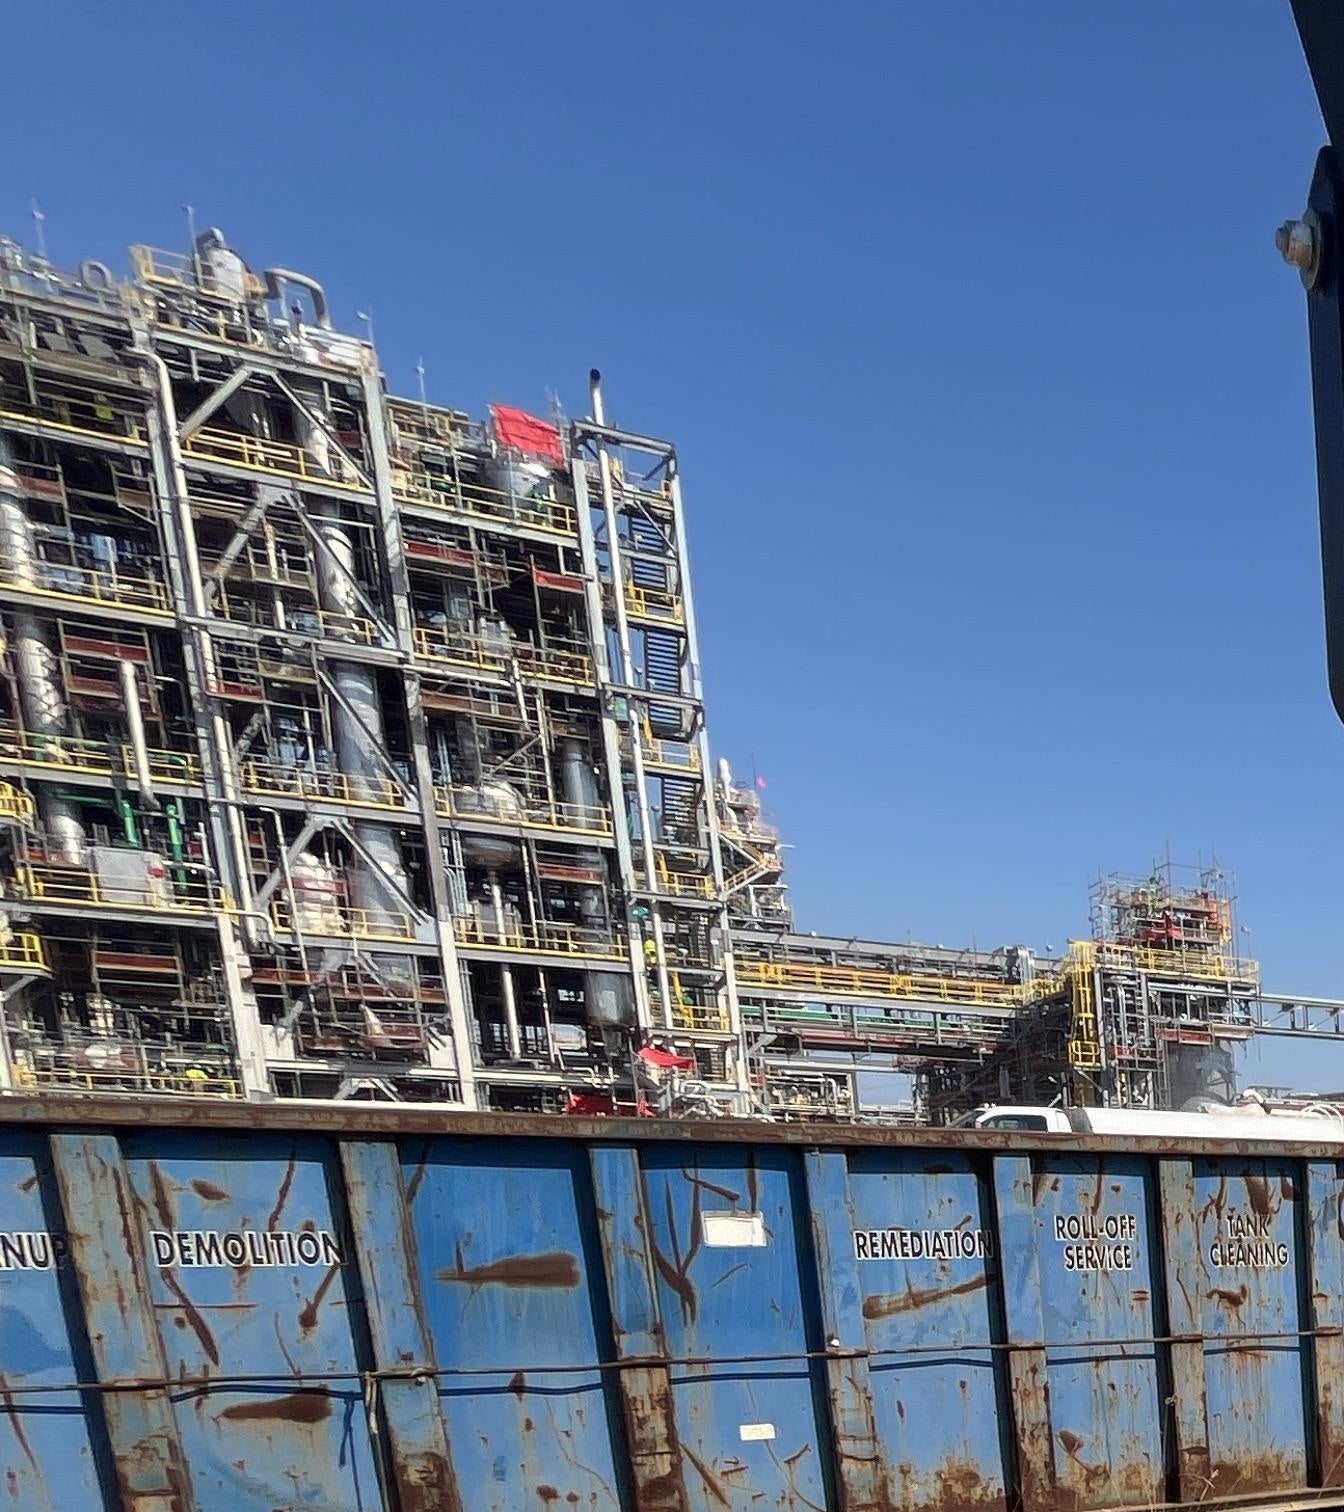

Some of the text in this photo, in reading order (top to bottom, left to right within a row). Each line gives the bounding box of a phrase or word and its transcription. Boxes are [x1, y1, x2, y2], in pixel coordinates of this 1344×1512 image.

[1054, 1213, 1137, 1242] ROLL-OFF
[1226, 1213, 1271, 1239] TANK
[0, 1231, 70, 1271] NUP
[150, 1230, 347, 1267] DEMOLITION
[853, 1230, 994, 1260] REMEDIATION
[1064, 1244, 1133, 1271] SERVICE
[1209, 1243, 1290, 1269] CLEANING
